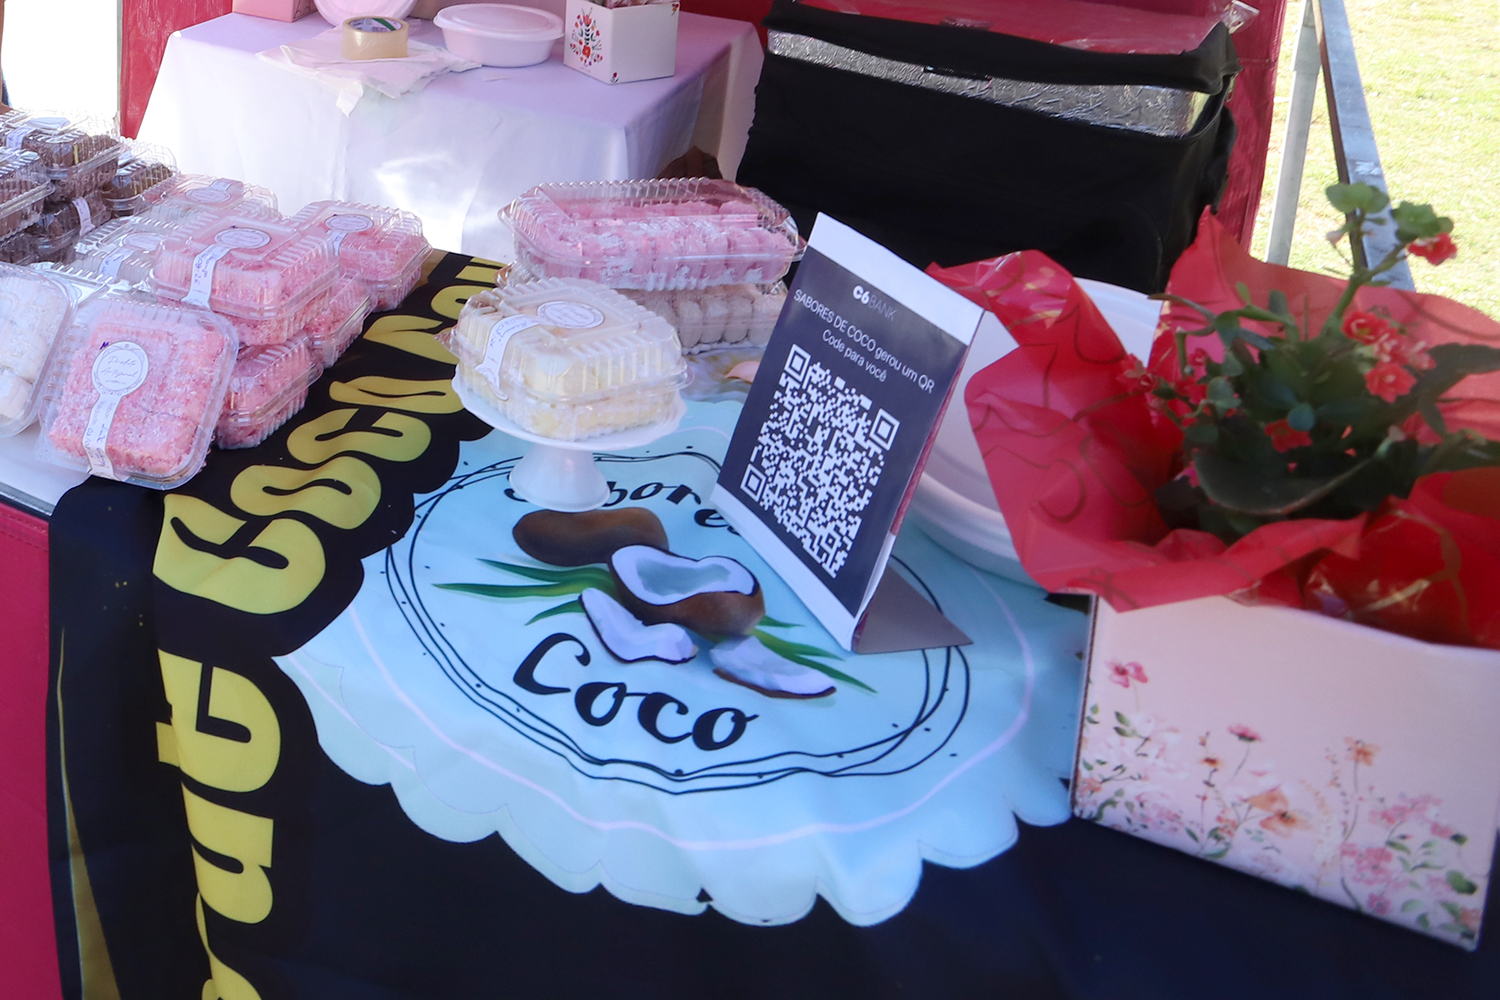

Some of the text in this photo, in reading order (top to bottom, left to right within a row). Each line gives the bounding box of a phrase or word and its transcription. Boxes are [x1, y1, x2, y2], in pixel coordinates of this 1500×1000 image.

[793, 289, 936, 394] SABORES DE COCO gerou um QR
[822, 329, 887, 382] Code para você
[512, 632, 759, 752] Coco
